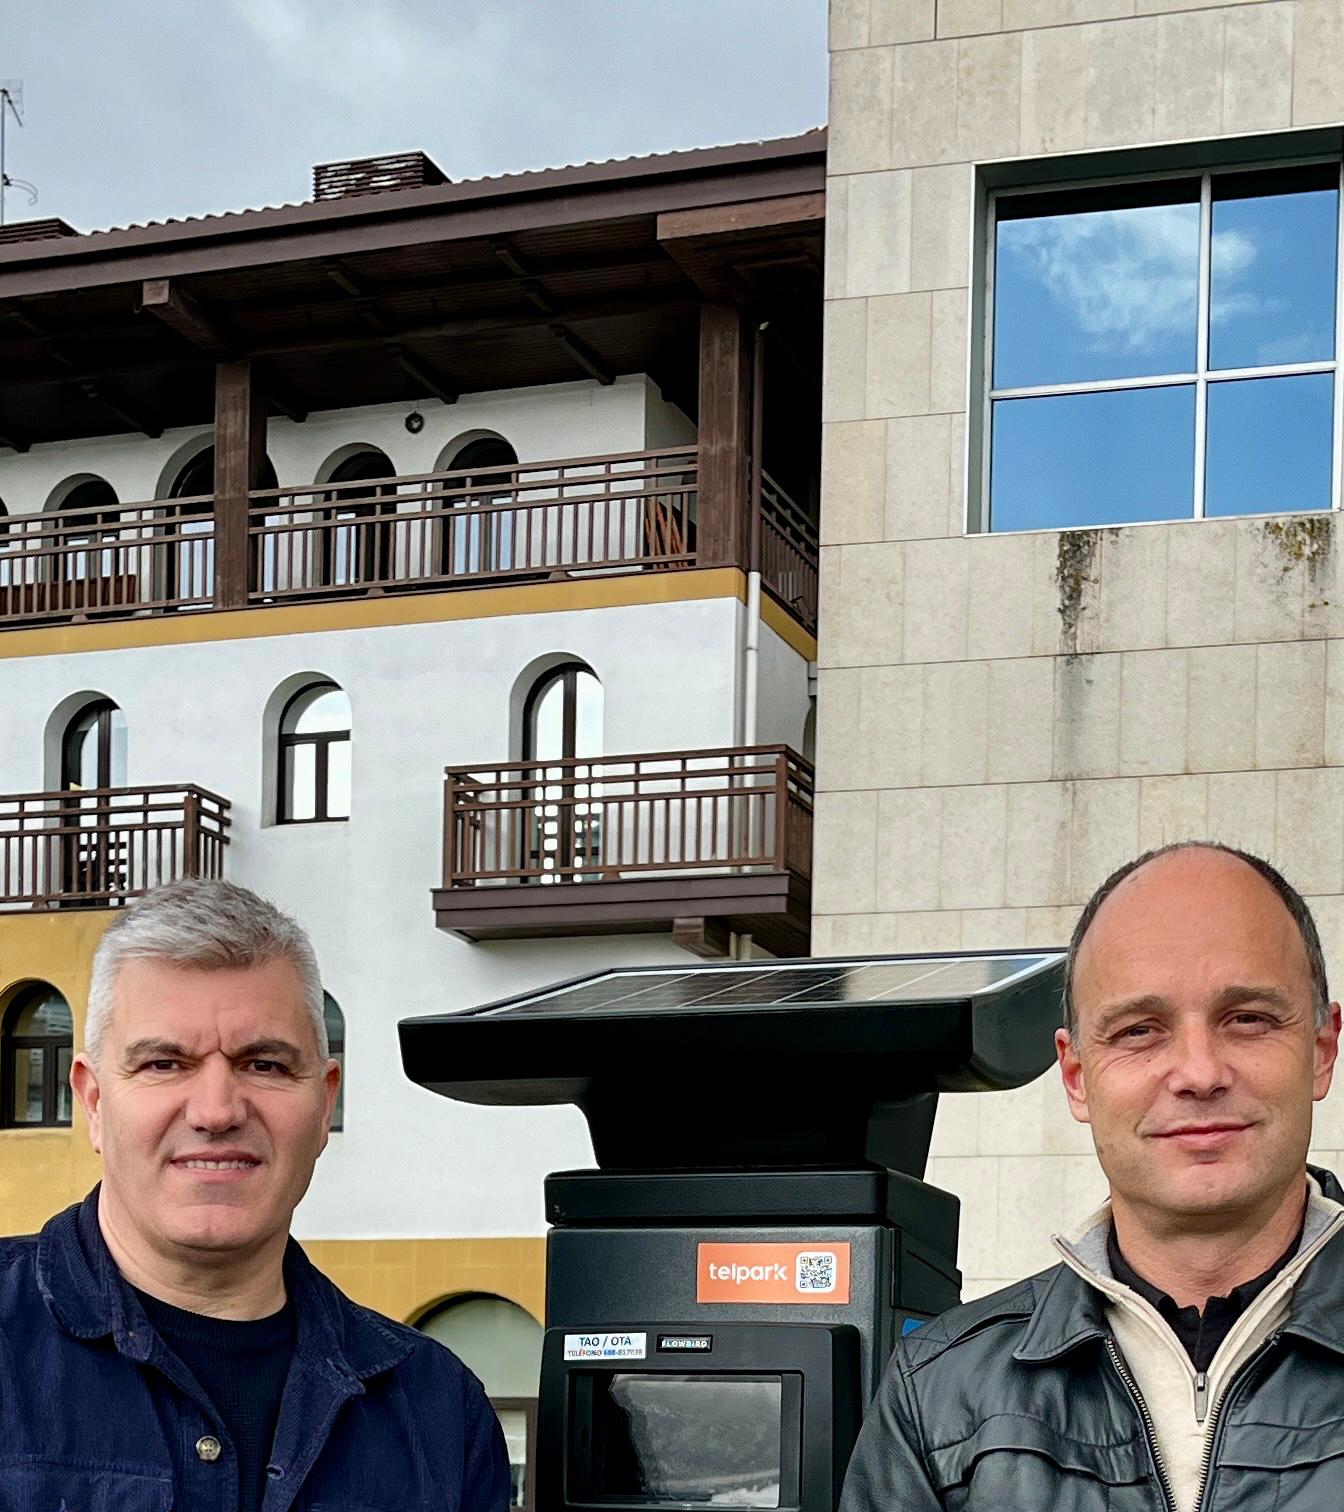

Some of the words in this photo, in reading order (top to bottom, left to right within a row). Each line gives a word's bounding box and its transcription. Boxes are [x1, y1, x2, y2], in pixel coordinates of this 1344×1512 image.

[708, 1263, 789, 1285] telpark
[579, 1337, 600, 1347] TAO
[602, 1336, 608, 1347] /
[610, 1336, 632, 1346] OTA
